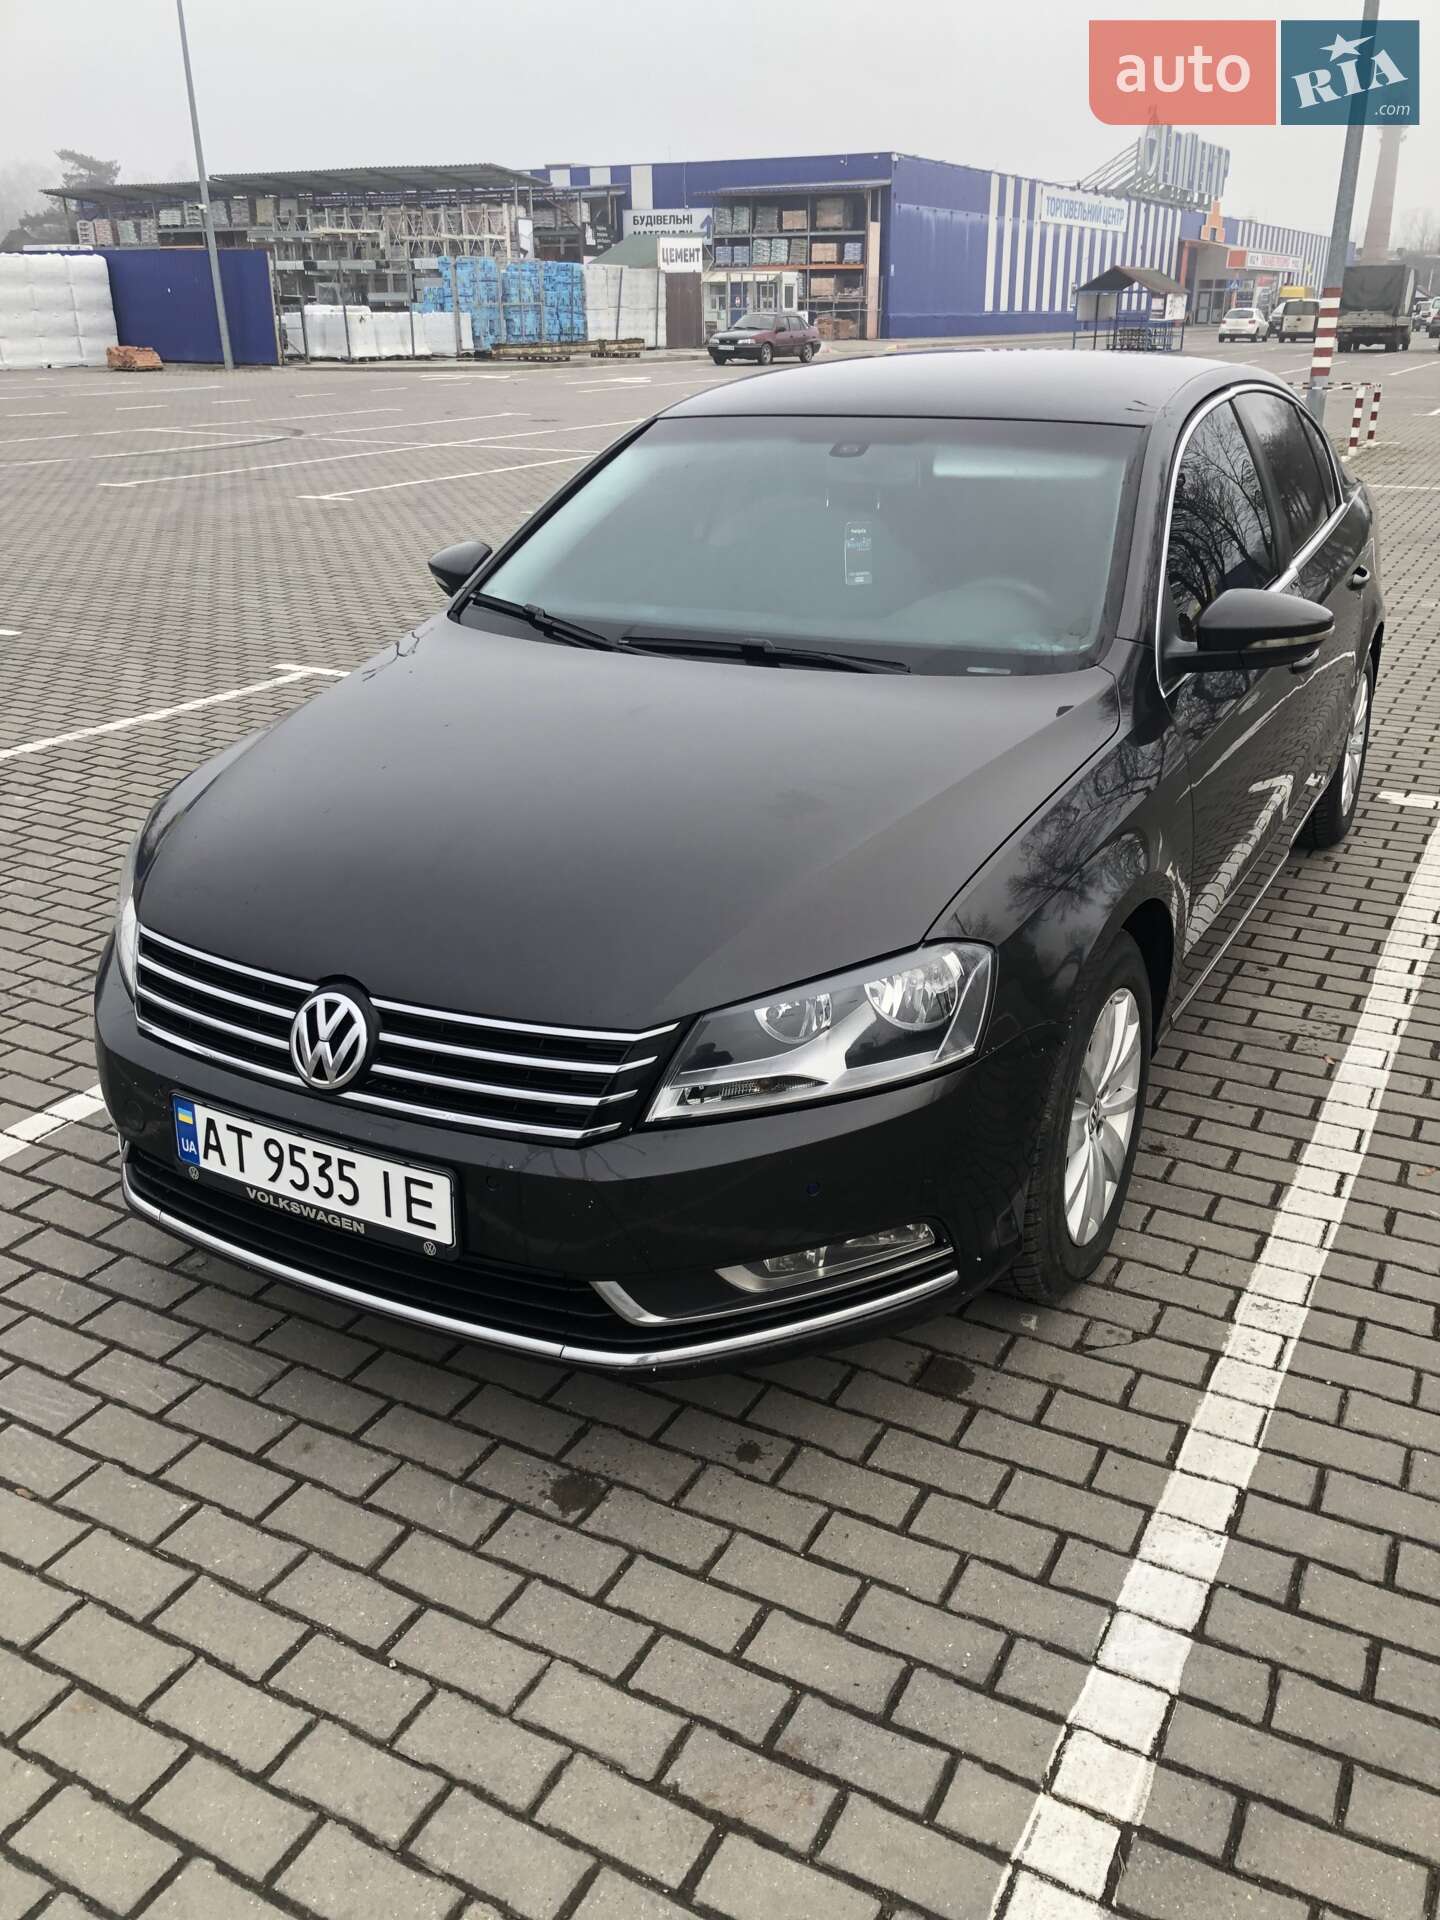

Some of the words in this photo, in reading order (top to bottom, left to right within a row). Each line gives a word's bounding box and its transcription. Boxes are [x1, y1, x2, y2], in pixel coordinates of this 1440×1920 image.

[632, 214, 693, 227] БУДІВЕЛЬНІ
[1046, 195, 1103, 225] ТОРГОВЕЛЬНИЙ
[1103, 207, 1125, 227] ЦЕНТР
[662, 247, 700, 265] ЦЕМЕНТ
[181, 1138, 197, 1155] UA
[203, 1117, 252, 1173] AT
[264, 1138, 359, 1206] 9535
[383, 1171, 437, 1230] IE
[246, 1187, 365, 1234] VOLKSWAGEN
